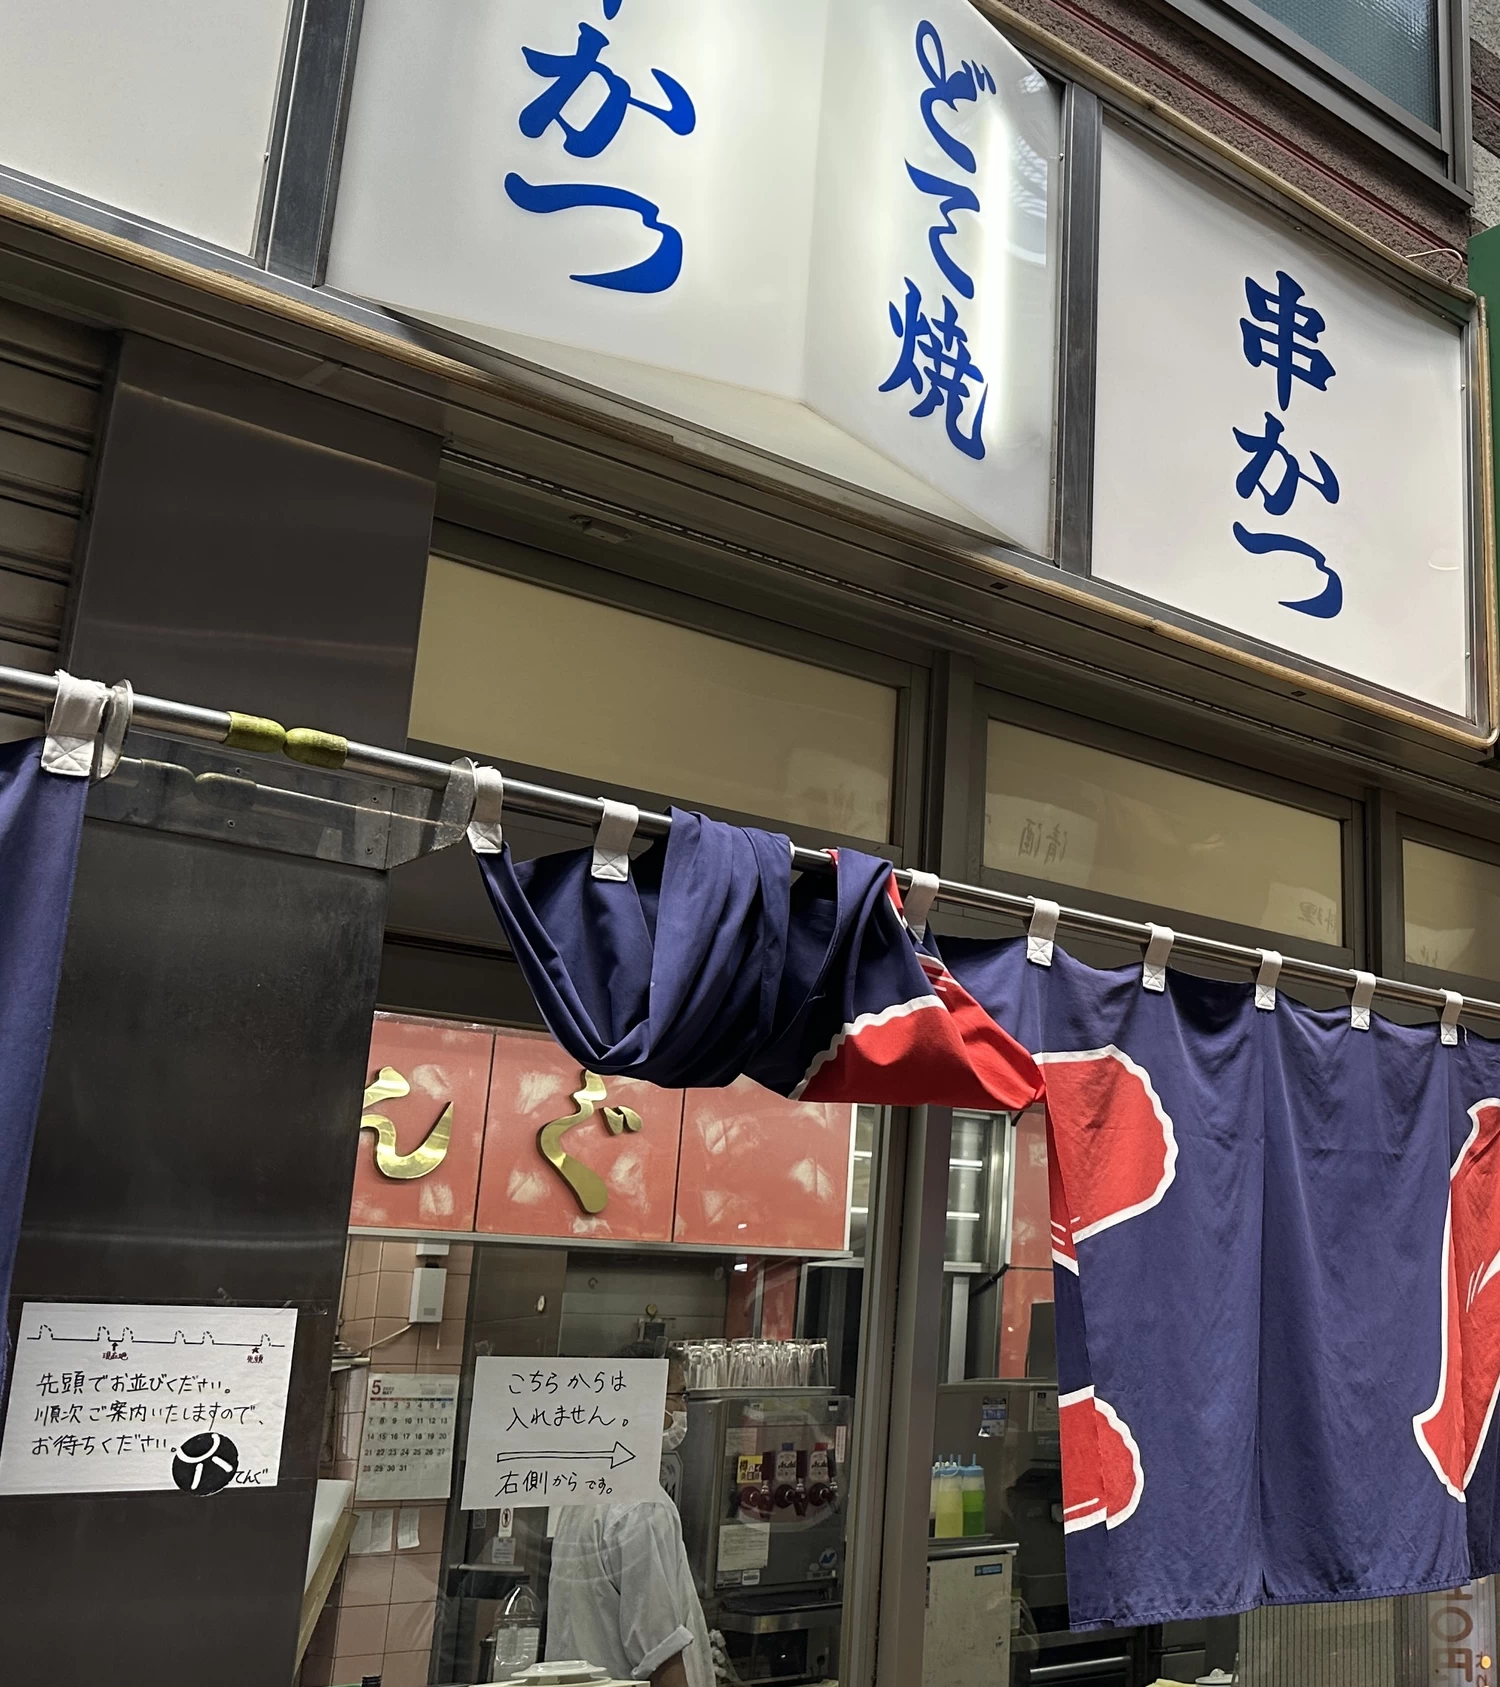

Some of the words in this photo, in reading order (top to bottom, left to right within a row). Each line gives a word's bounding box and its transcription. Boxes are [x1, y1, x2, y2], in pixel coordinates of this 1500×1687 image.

[504, 0, 697, 294] かつ
[878, 20, 996, 460] どて焼
[1231, 270, 1343, 619] 串かつ
[36, 1371, 231, 1396] 先頭でお並びください。
[371, 1380, 381, 1395] 5
[508, 1371, 627, 1394] こちらからは
[34, 1400, 264, 1431] 順次ご案内いたしますので、
[505, 1405, 630, 1431] 入れません。
[31, 1434, 177, 1457] お待ちください。
[235, 1468, 269, 1485] てんぐ
[495, 1470, 613, 1497] 右側からです。
